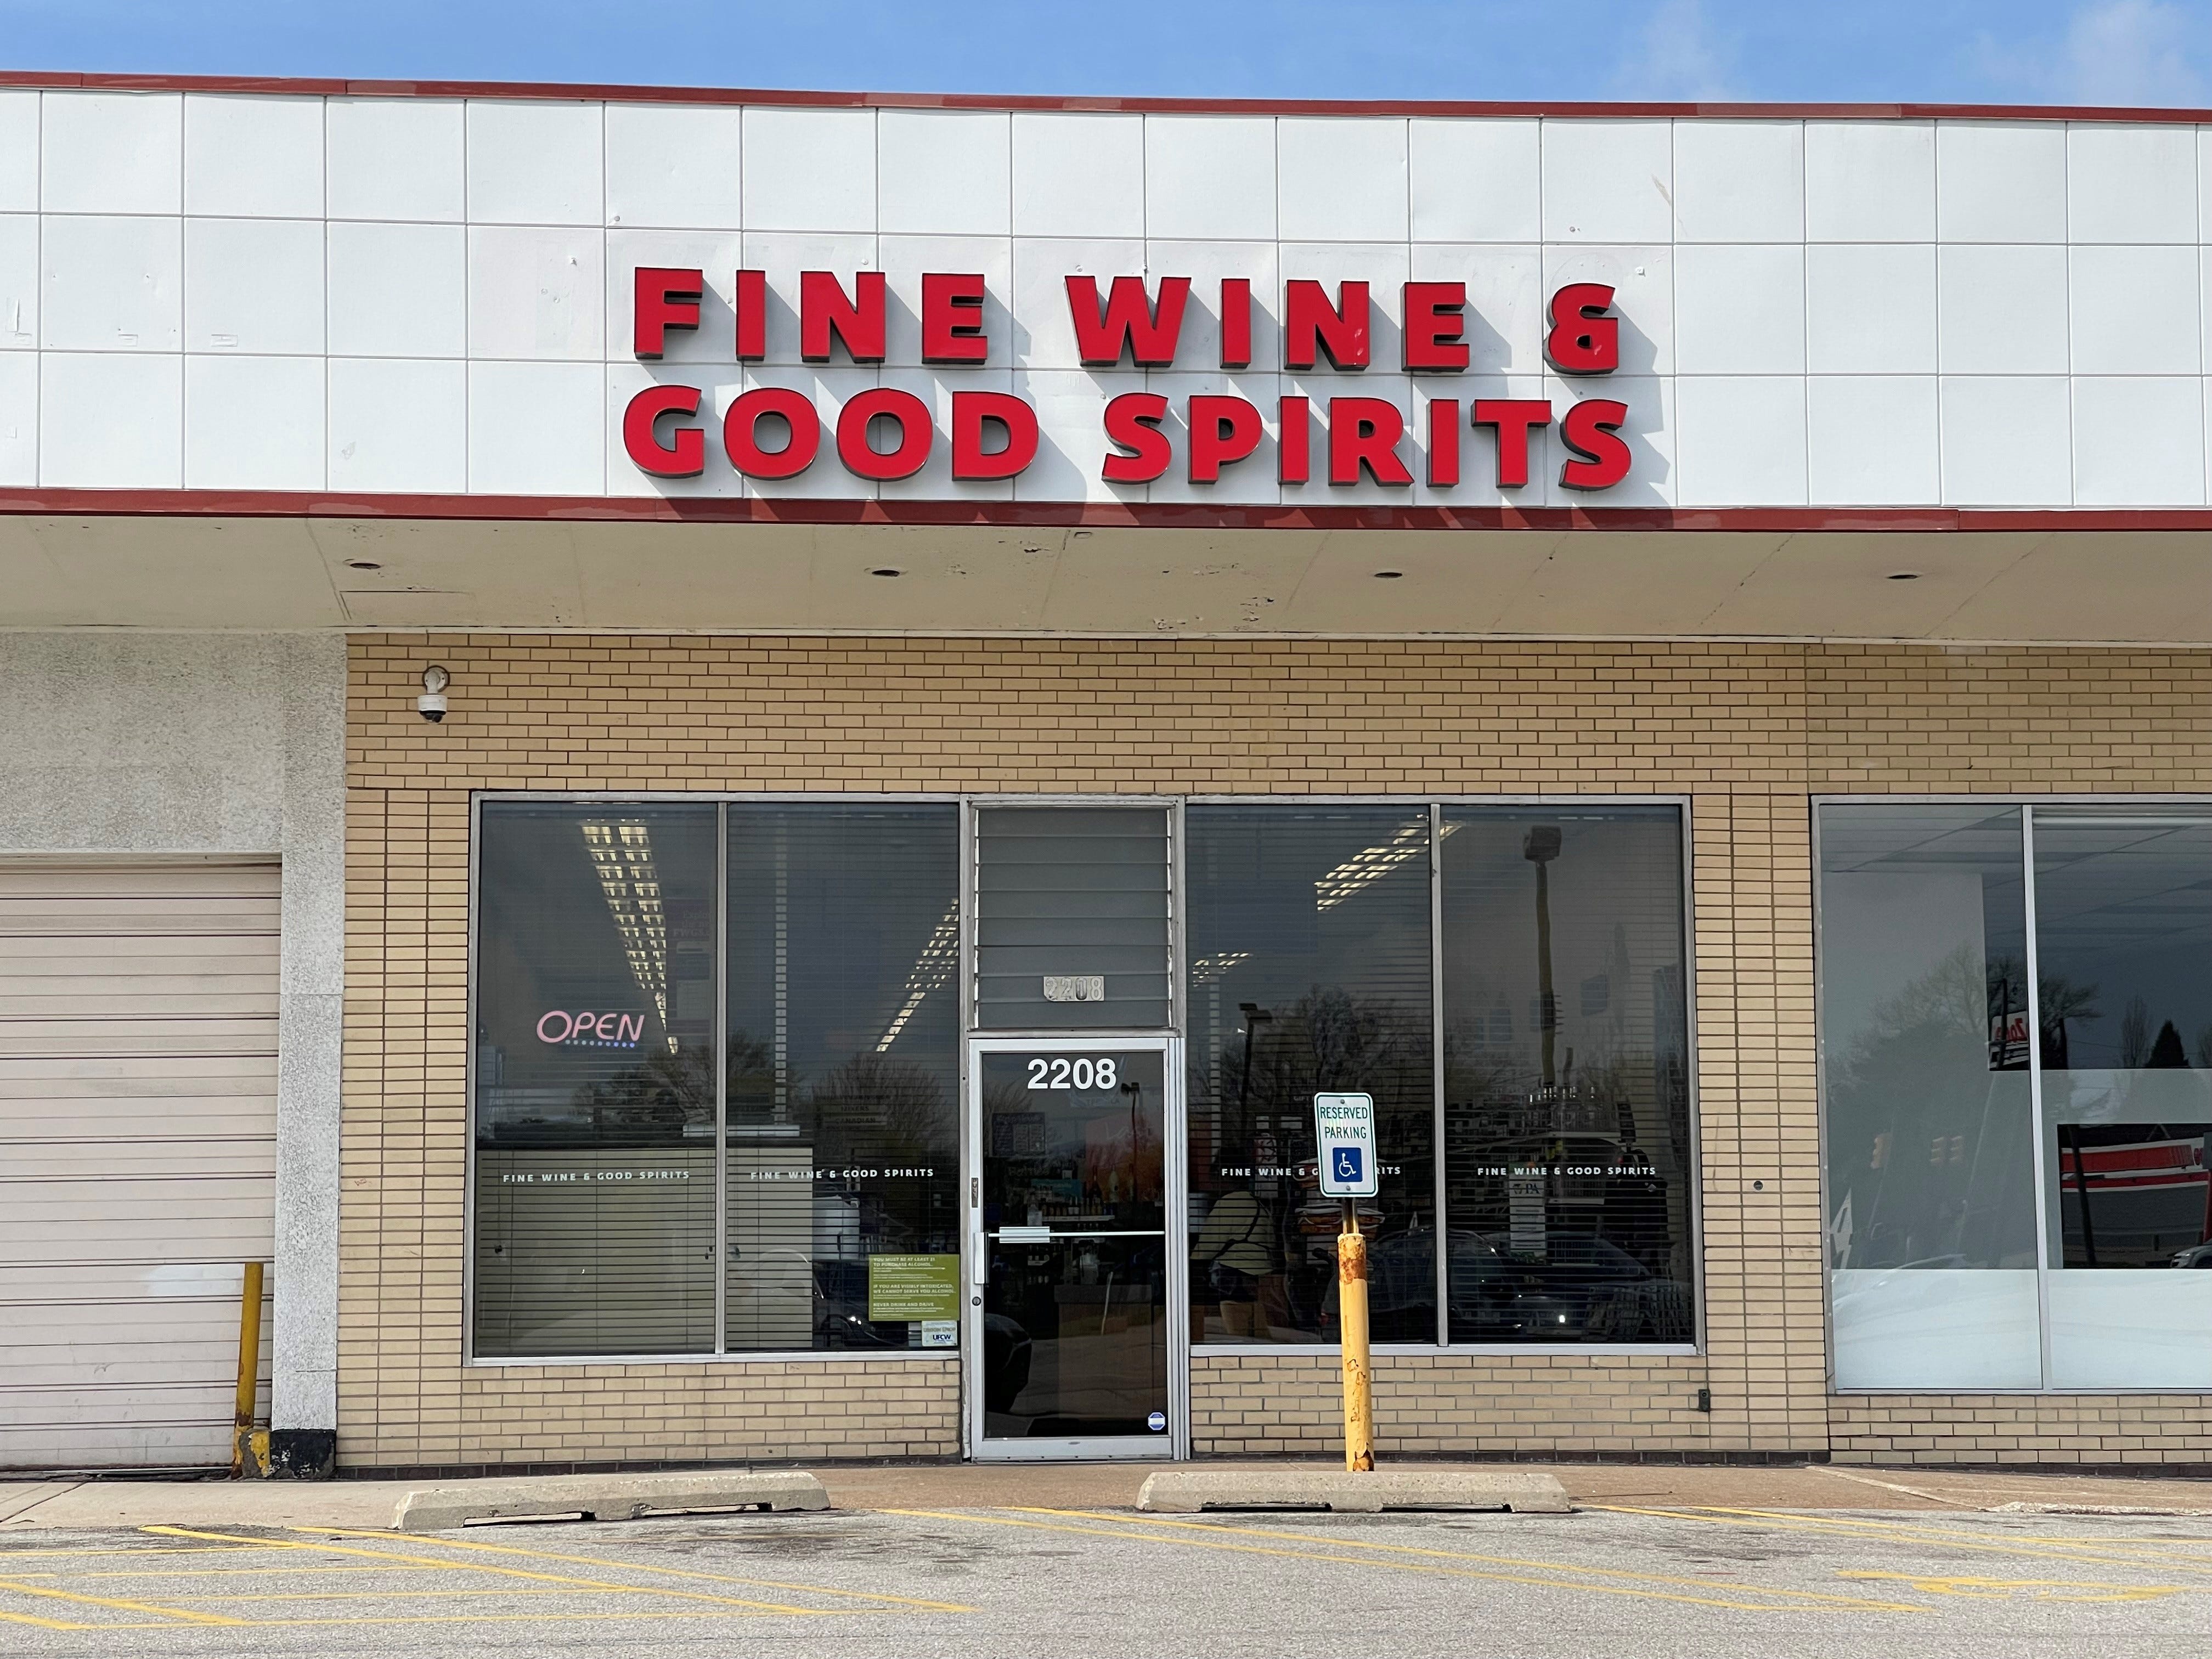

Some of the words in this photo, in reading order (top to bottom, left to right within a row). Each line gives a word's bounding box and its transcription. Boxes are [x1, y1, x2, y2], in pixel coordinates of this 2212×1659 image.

[634, 267, 989, 363] FINE
[1065, 275, 1471, 370] WINE
[1543, 283, 1619, 375] &
[623, 385, 1040, 482] GOOD
[1102, 392, 1632, 490] SPIRITS
[1045, 977, 1103, 1001] 2208
[536, 1010, 645, 1043] OPEN
[1027, 1058, 1117, 1090] 2208
[1320, 1107, 1368, 1119] RESERVED
[1324, 1126, 1367, 1139] PARKING
[541, 1173, 576, 1182] WINE
[597, 1172, 632, 1180] GOOD
[639, 1171, 690, 1180] SPIRITS
[751, 1172, 781, 1180] FINE
[788, 1171, 822, 1179] WINE
[830, 1170, 836, 1178] &
[843, 1170, 878, 1178] GOOD
[884, 1169, 934, 1177] SPIRITS
[1221, 1168, 1251, 1176] FINE
[1477, 1167, 1507, 1176] FINE
[1514, 1167, 1547, 1175] WINE
[1567, 1166, 1601, 1175] GOOD
[1607, 1166, 1656, 1175] SPIRITS
